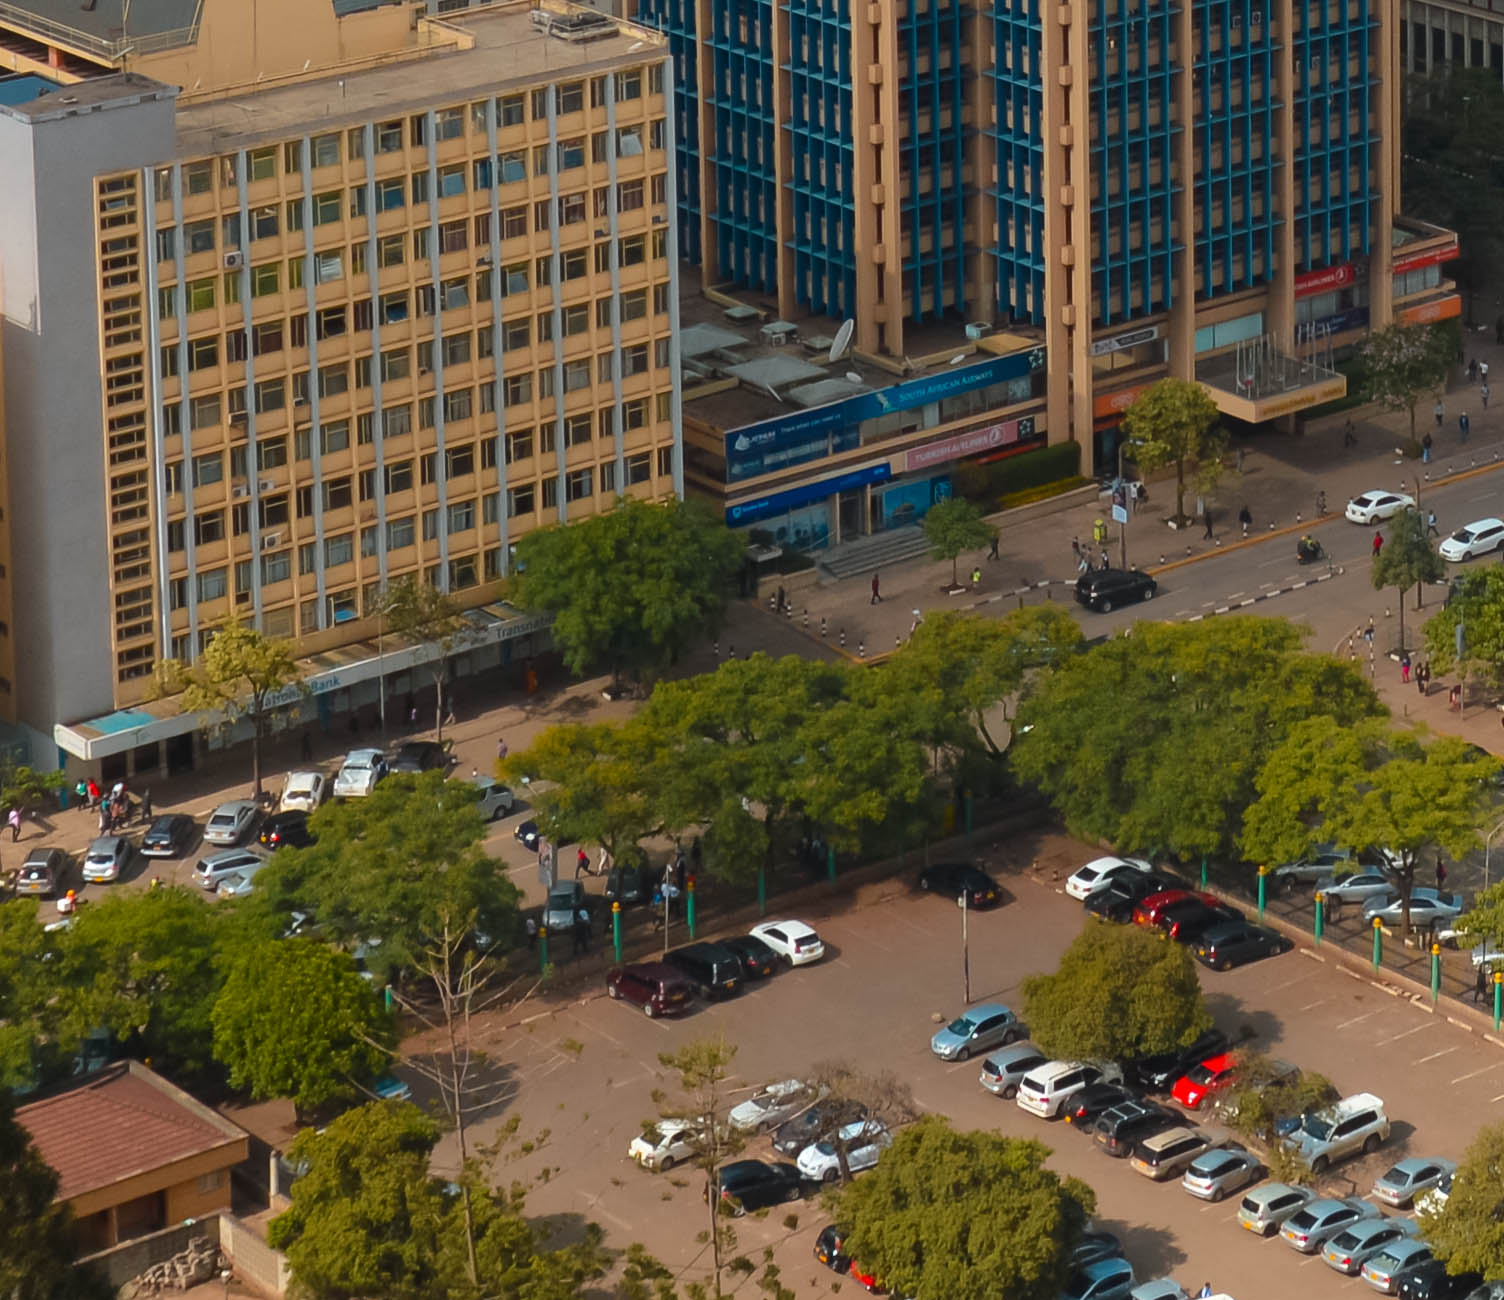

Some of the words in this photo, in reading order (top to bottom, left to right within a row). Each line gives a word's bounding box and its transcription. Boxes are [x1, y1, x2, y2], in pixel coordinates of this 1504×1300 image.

[899, 387, 926, 403] SOUTH
[927, 378, 961, 395] AFRICAN
[961, 369, 993, 385] AIRWAYS
[914, 446, 951, 463] TURKISH
[311, 675, 341, 696] Bank
